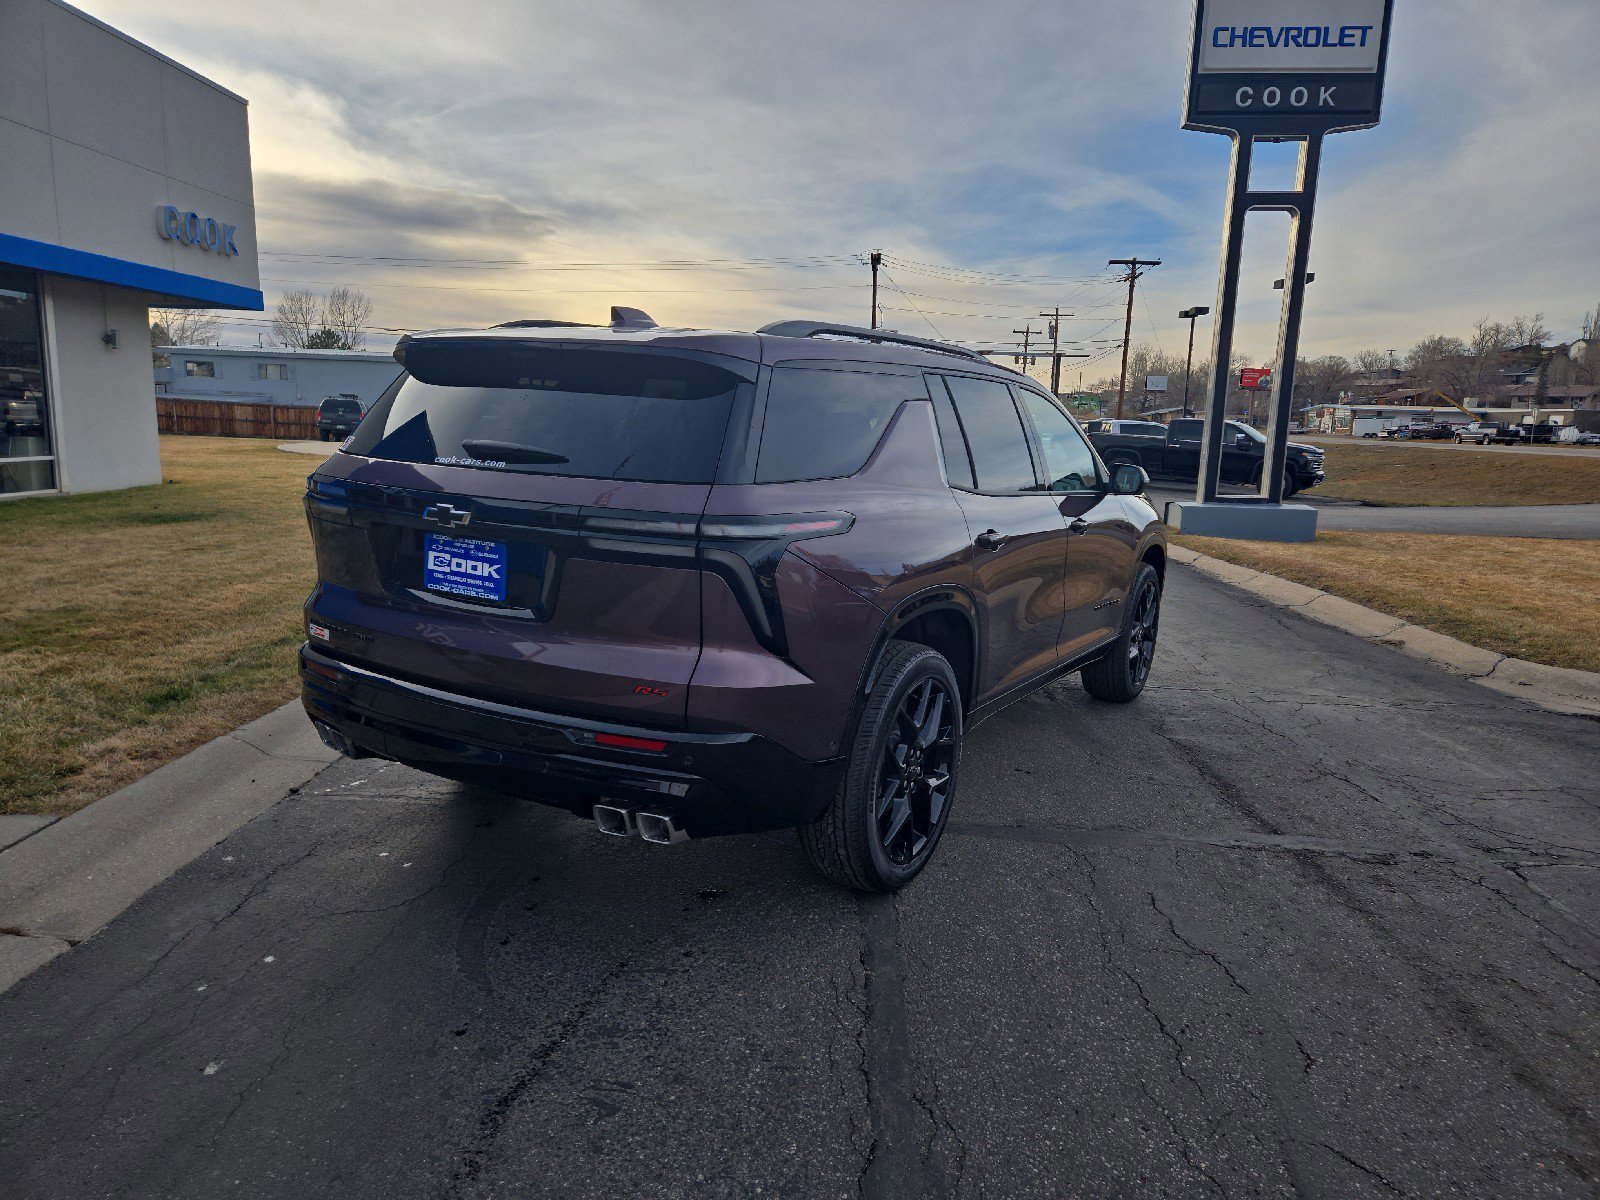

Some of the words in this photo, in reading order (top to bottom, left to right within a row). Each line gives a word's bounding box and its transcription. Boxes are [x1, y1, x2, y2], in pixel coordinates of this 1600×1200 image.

[1212, 25, 1374, 48] CHEVROLET
[1234, 86, 1338, 108] COOK
[157, 205, 239, 256] COOK
[434, 455, 506, 468] cook-cars.com
[427, 550, 502, 579] COOK
[634, 685, 669, 697] RS
